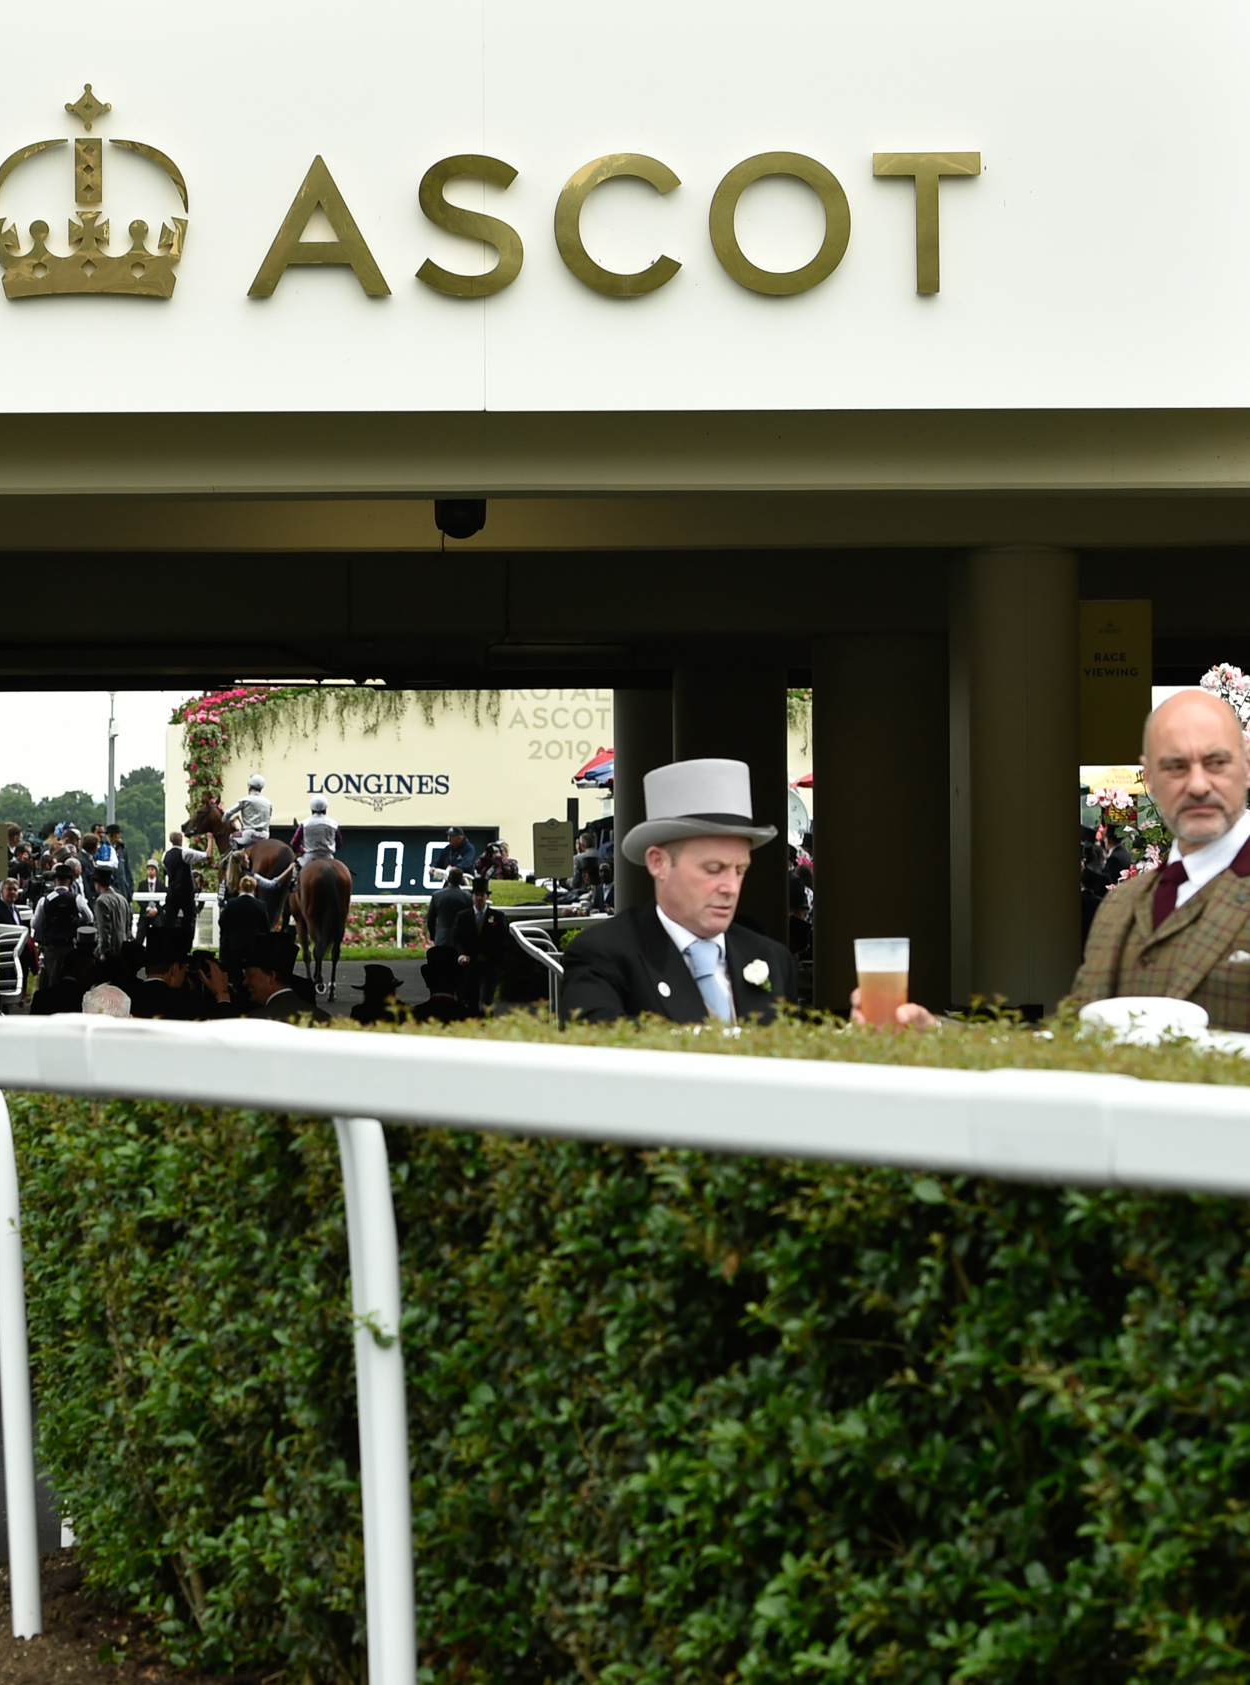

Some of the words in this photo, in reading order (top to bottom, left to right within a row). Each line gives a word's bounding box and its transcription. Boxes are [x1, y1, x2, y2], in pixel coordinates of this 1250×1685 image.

[246, 150, 982, 298] ASCOT
[1094, 652, 1127, 662] RACE
[1083, 667, 1139, 677] VIEWING
[508, 707, 612, 730] ASCOT
[527, 739, 593, 764] 2019
[306, 773, 451, 796] LONGINES
